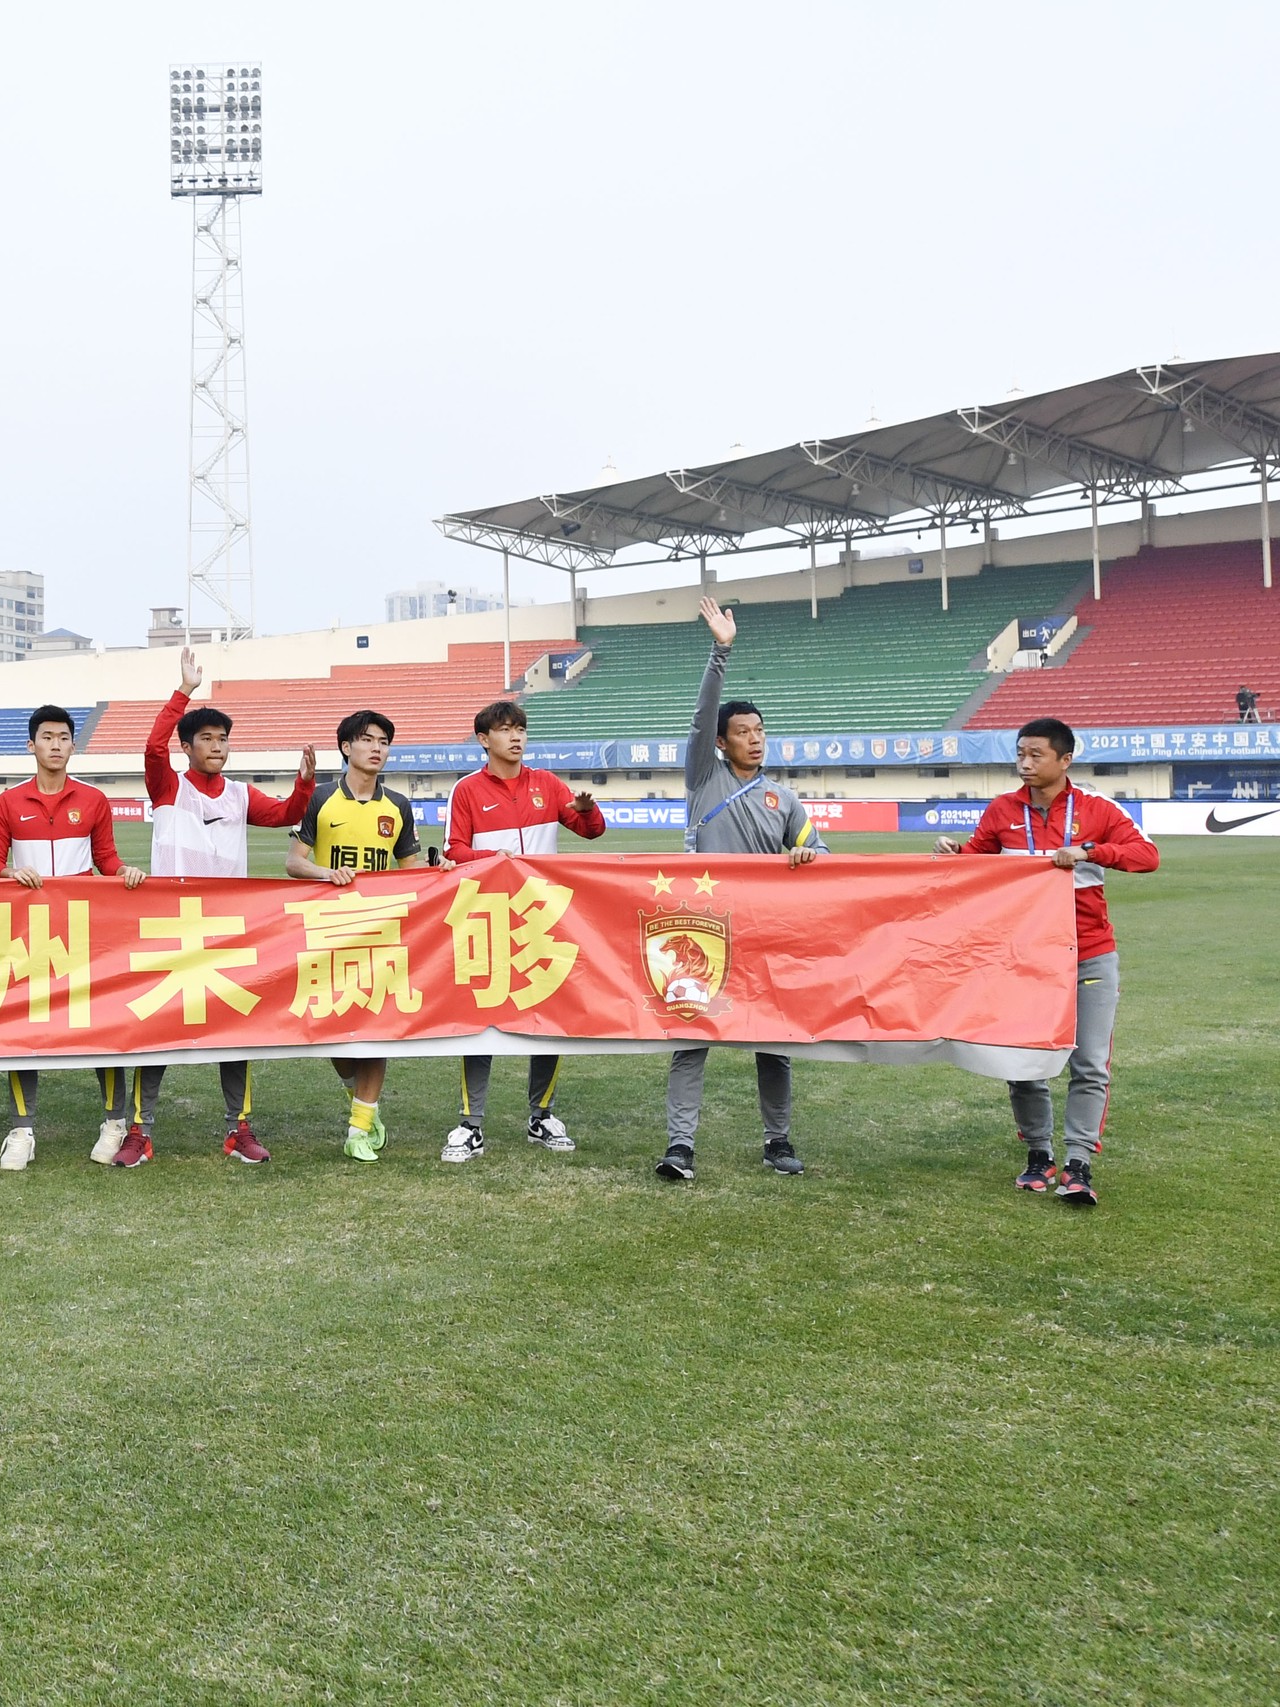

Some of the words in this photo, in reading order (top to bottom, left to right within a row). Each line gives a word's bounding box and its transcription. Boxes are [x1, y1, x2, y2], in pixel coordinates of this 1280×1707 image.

[1022, 629, 1037, 638] 出口
[1091, 731, 1280, 749] 2021中国平安中国足
[631, 743, 678, 763] 焕新
[1131, 748, 1150, 757] 2021
[1152, 748, 1172, 758] Ping
[1173, 748, 1186, 756] An
[1187, 747, 1223, 756] Chinese
[1225, 746, 1261, 755] Football
[600, 808, 686, 824] ROEWE
[330, 845, 389, 872] 恒驰
[649, 923, 660, 931] BE
[660, 920, 674, 928] THE
[691, 919, 721, 932] FOREVER
[666, 1003, 709, 1012] GUANGZHOU
